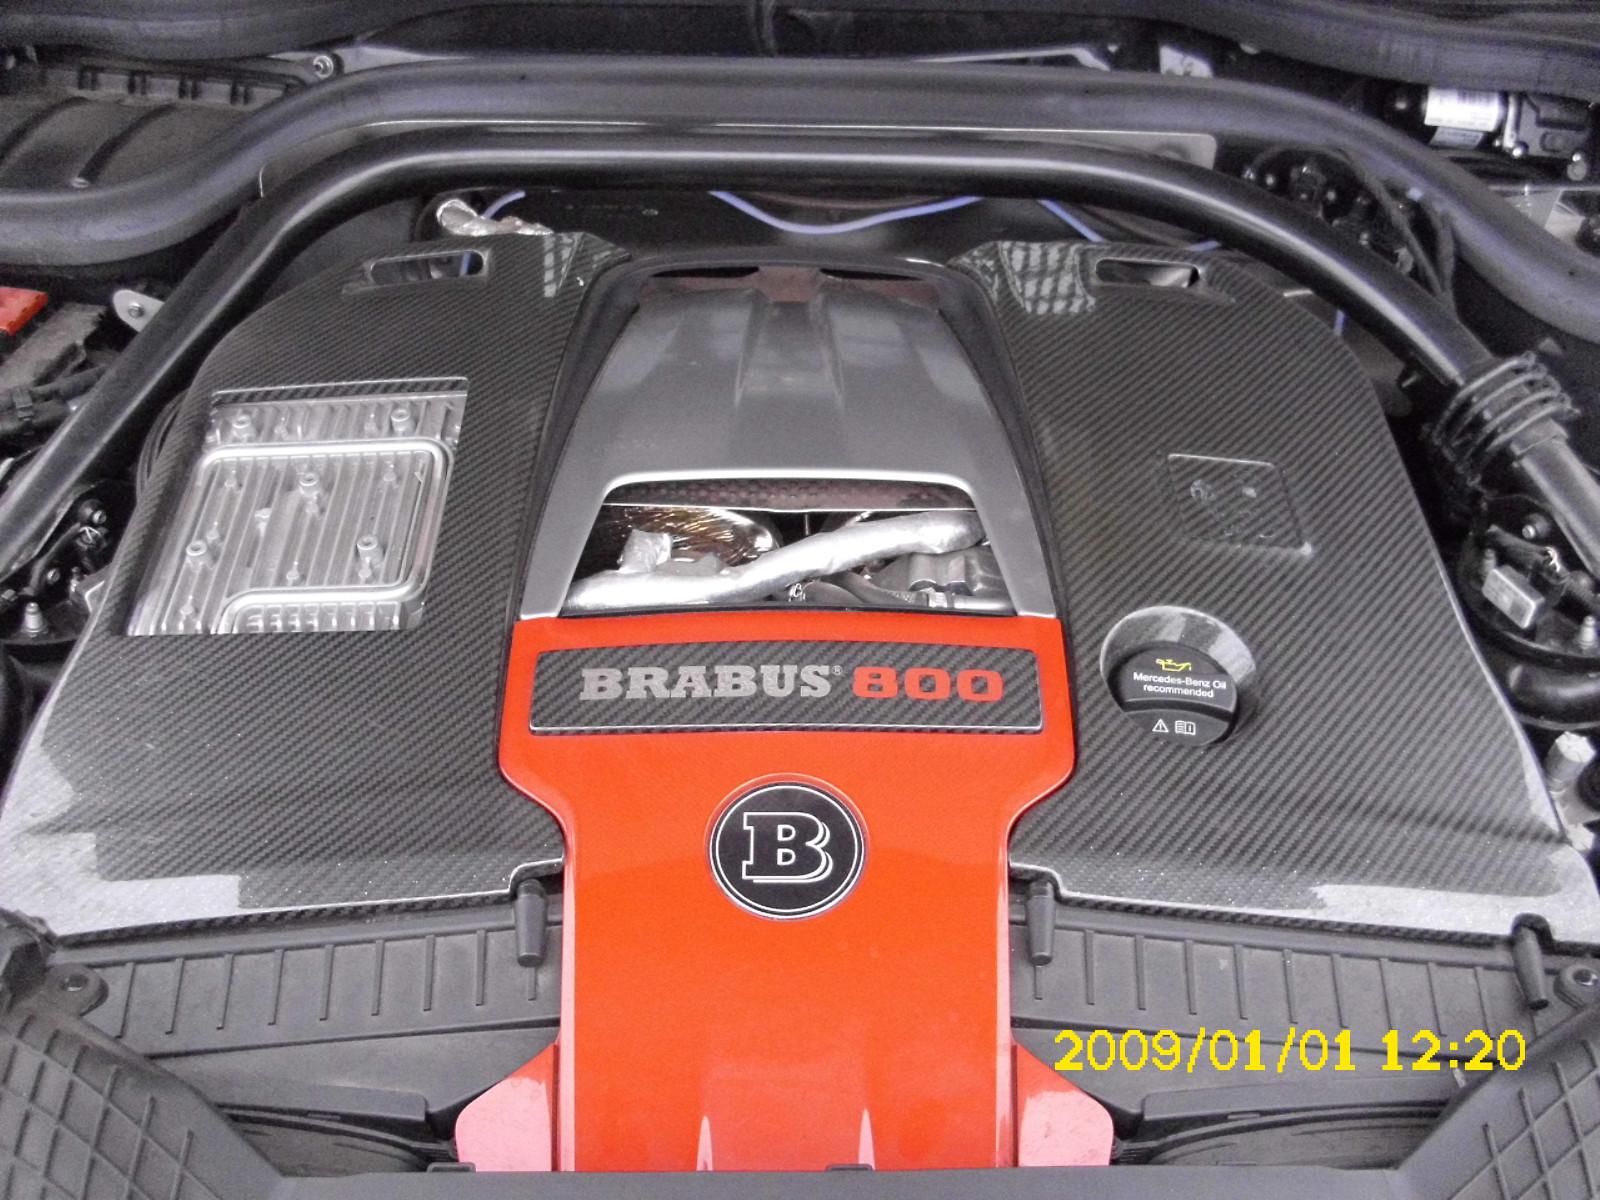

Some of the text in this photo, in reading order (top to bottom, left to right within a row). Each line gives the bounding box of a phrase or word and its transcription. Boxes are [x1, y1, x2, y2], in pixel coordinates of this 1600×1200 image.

[852, 666, 1004, 701] 800
[1133, 672, 1227, 690] Mercedes-Benz Oil
[1143, 684, 1214, 698] recommended
[741, 811, 834, 883] B
